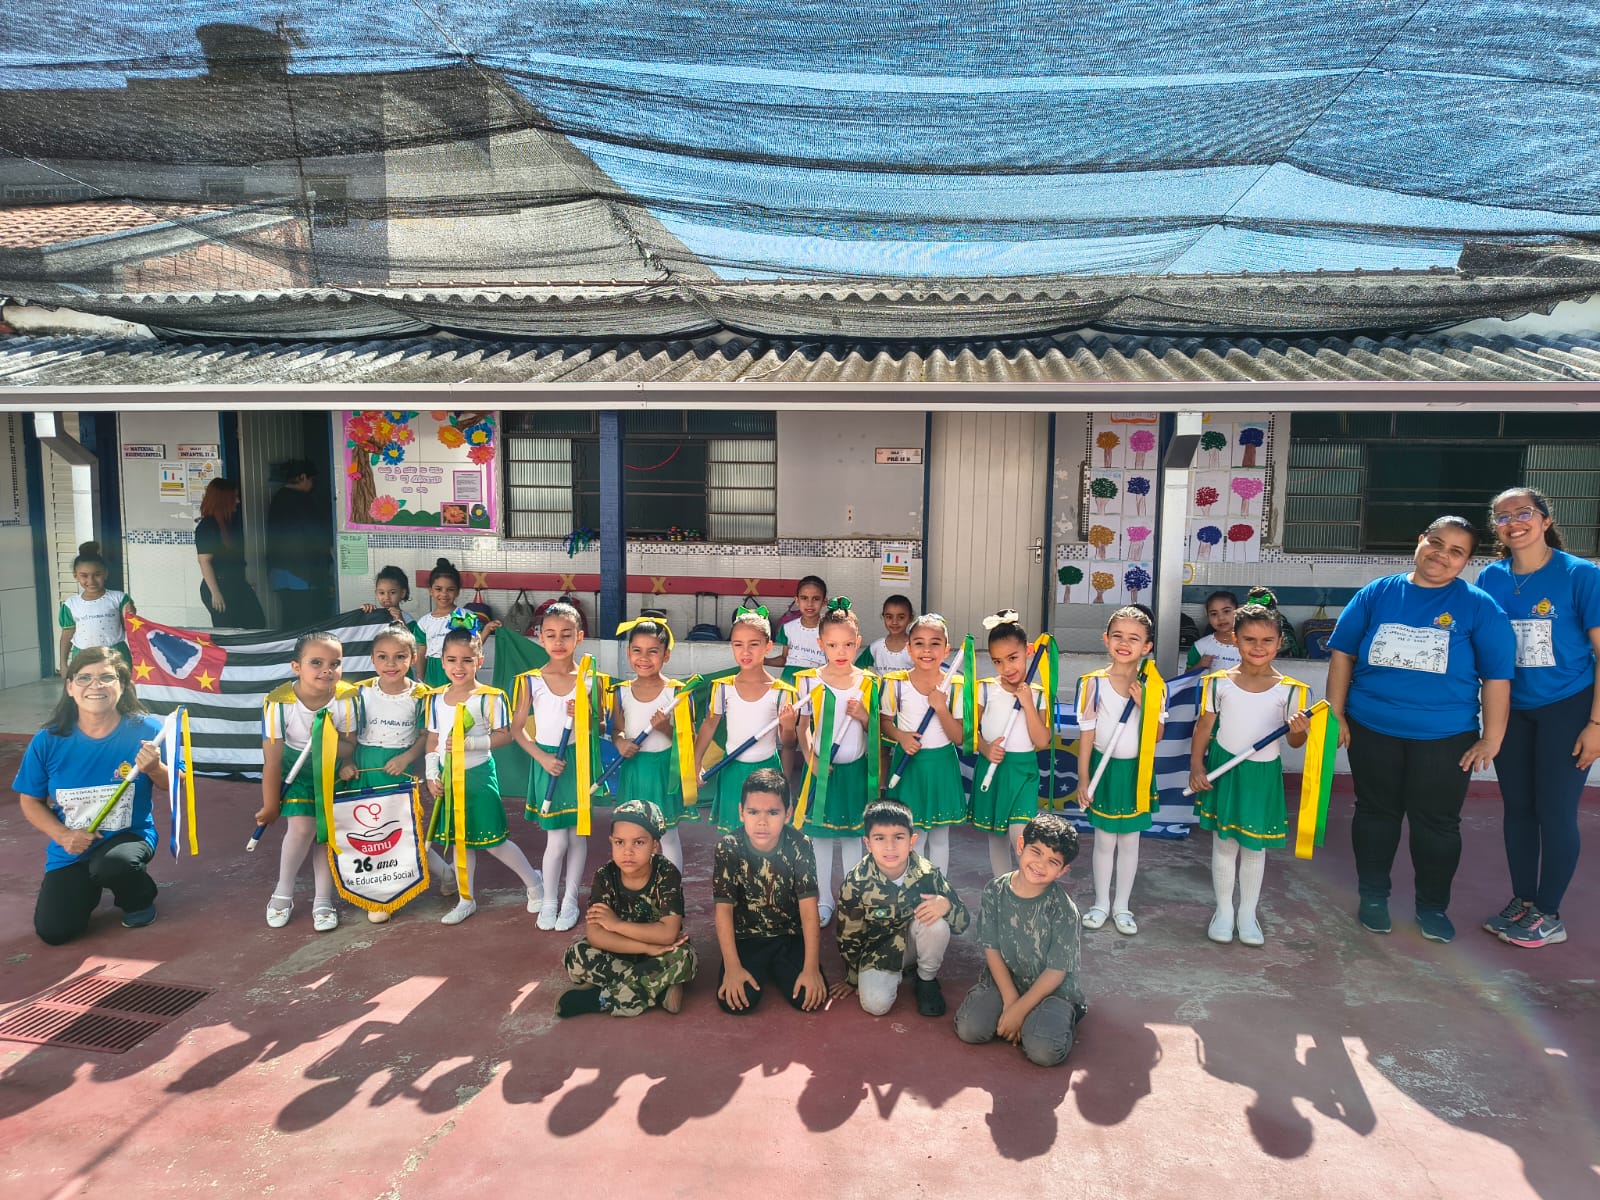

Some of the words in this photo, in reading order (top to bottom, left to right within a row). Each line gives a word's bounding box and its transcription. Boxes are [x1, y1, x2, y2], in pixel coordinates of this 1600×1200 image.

[380, 719, 401, 727] MARIA
[361, 840, 392, 853] aamu
[353, 856, 373, 874] 26
[376, 858, 399, 870] anos
[355, 873, 392, 886] Educação
[393, 870, 415, 880] Social
